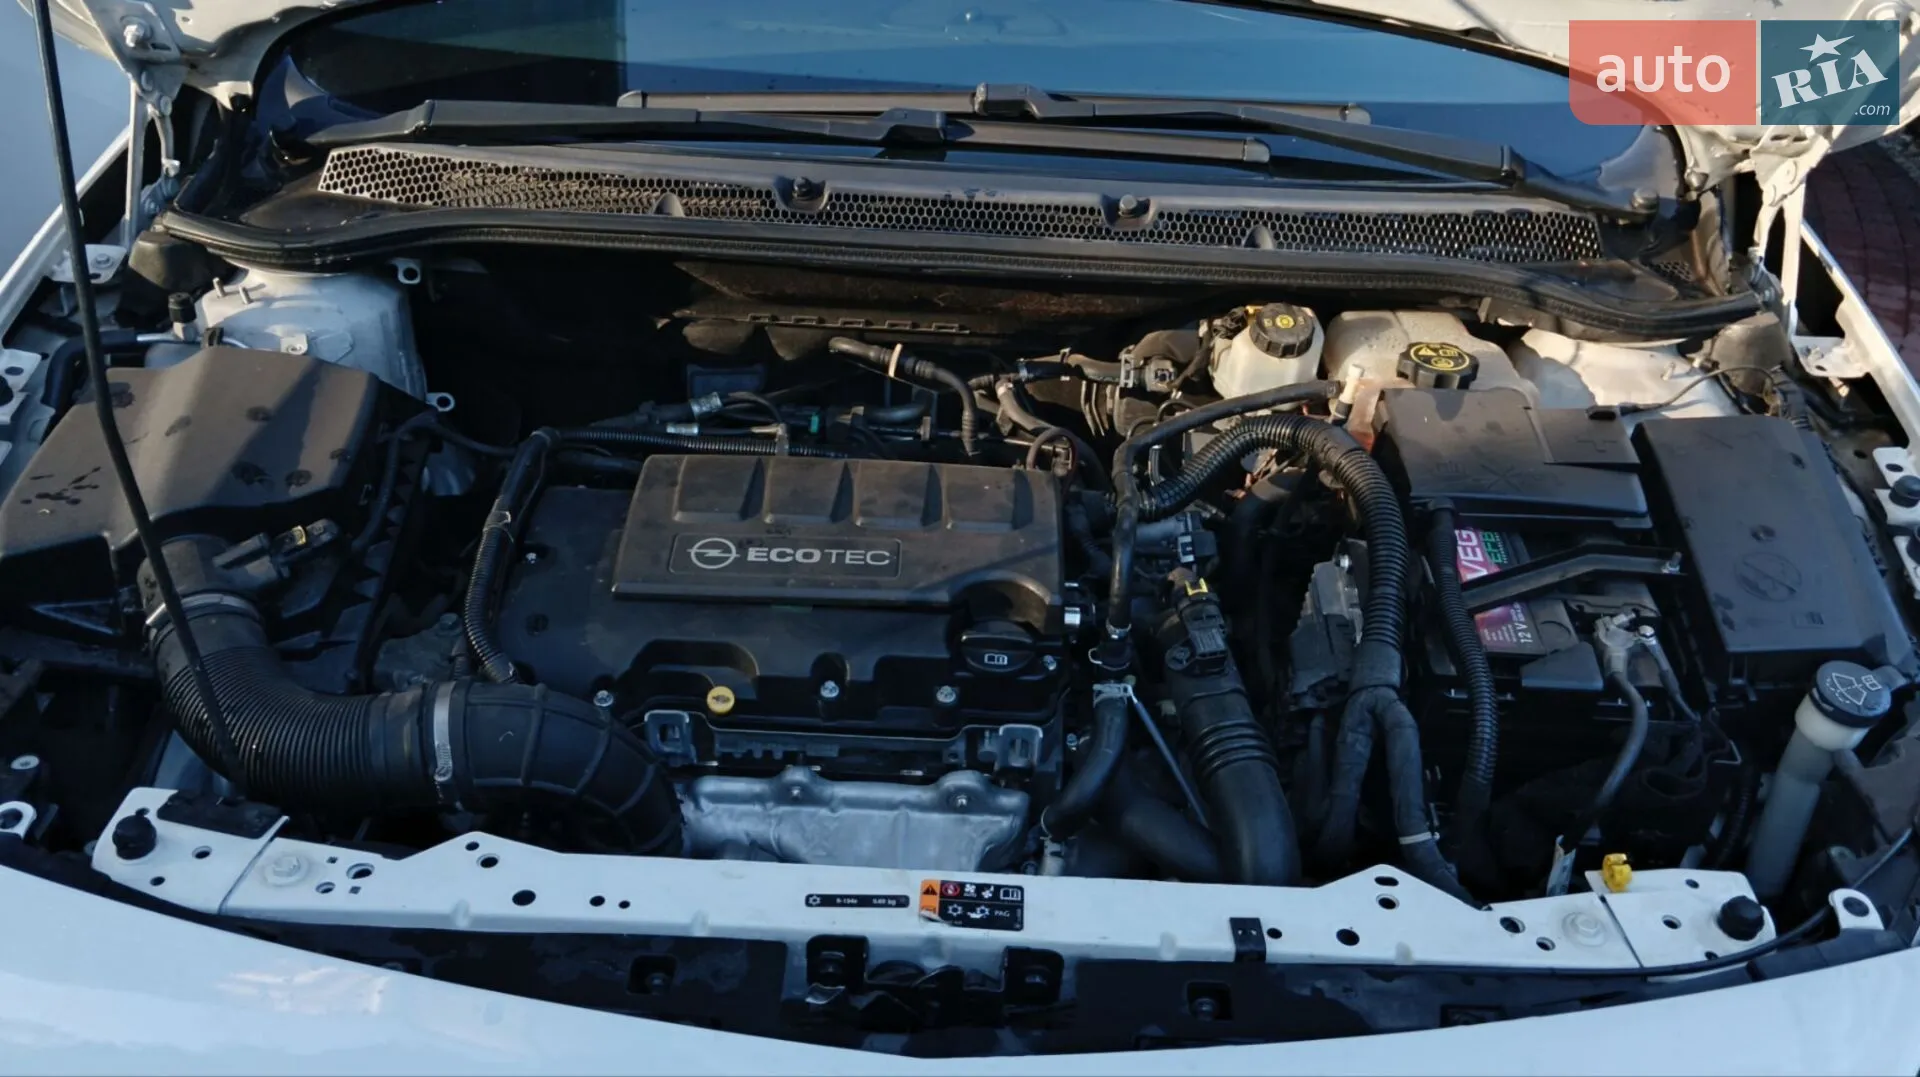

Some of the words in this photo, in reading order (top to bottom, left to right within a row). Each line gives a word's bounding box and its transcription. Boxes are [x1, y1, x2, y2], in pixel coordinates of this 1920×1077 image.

[747, 546, 890, 566] ECOTEC
[1455, 528, 1488, 580] VEG
[994, 909, 1011, 917] PAG
